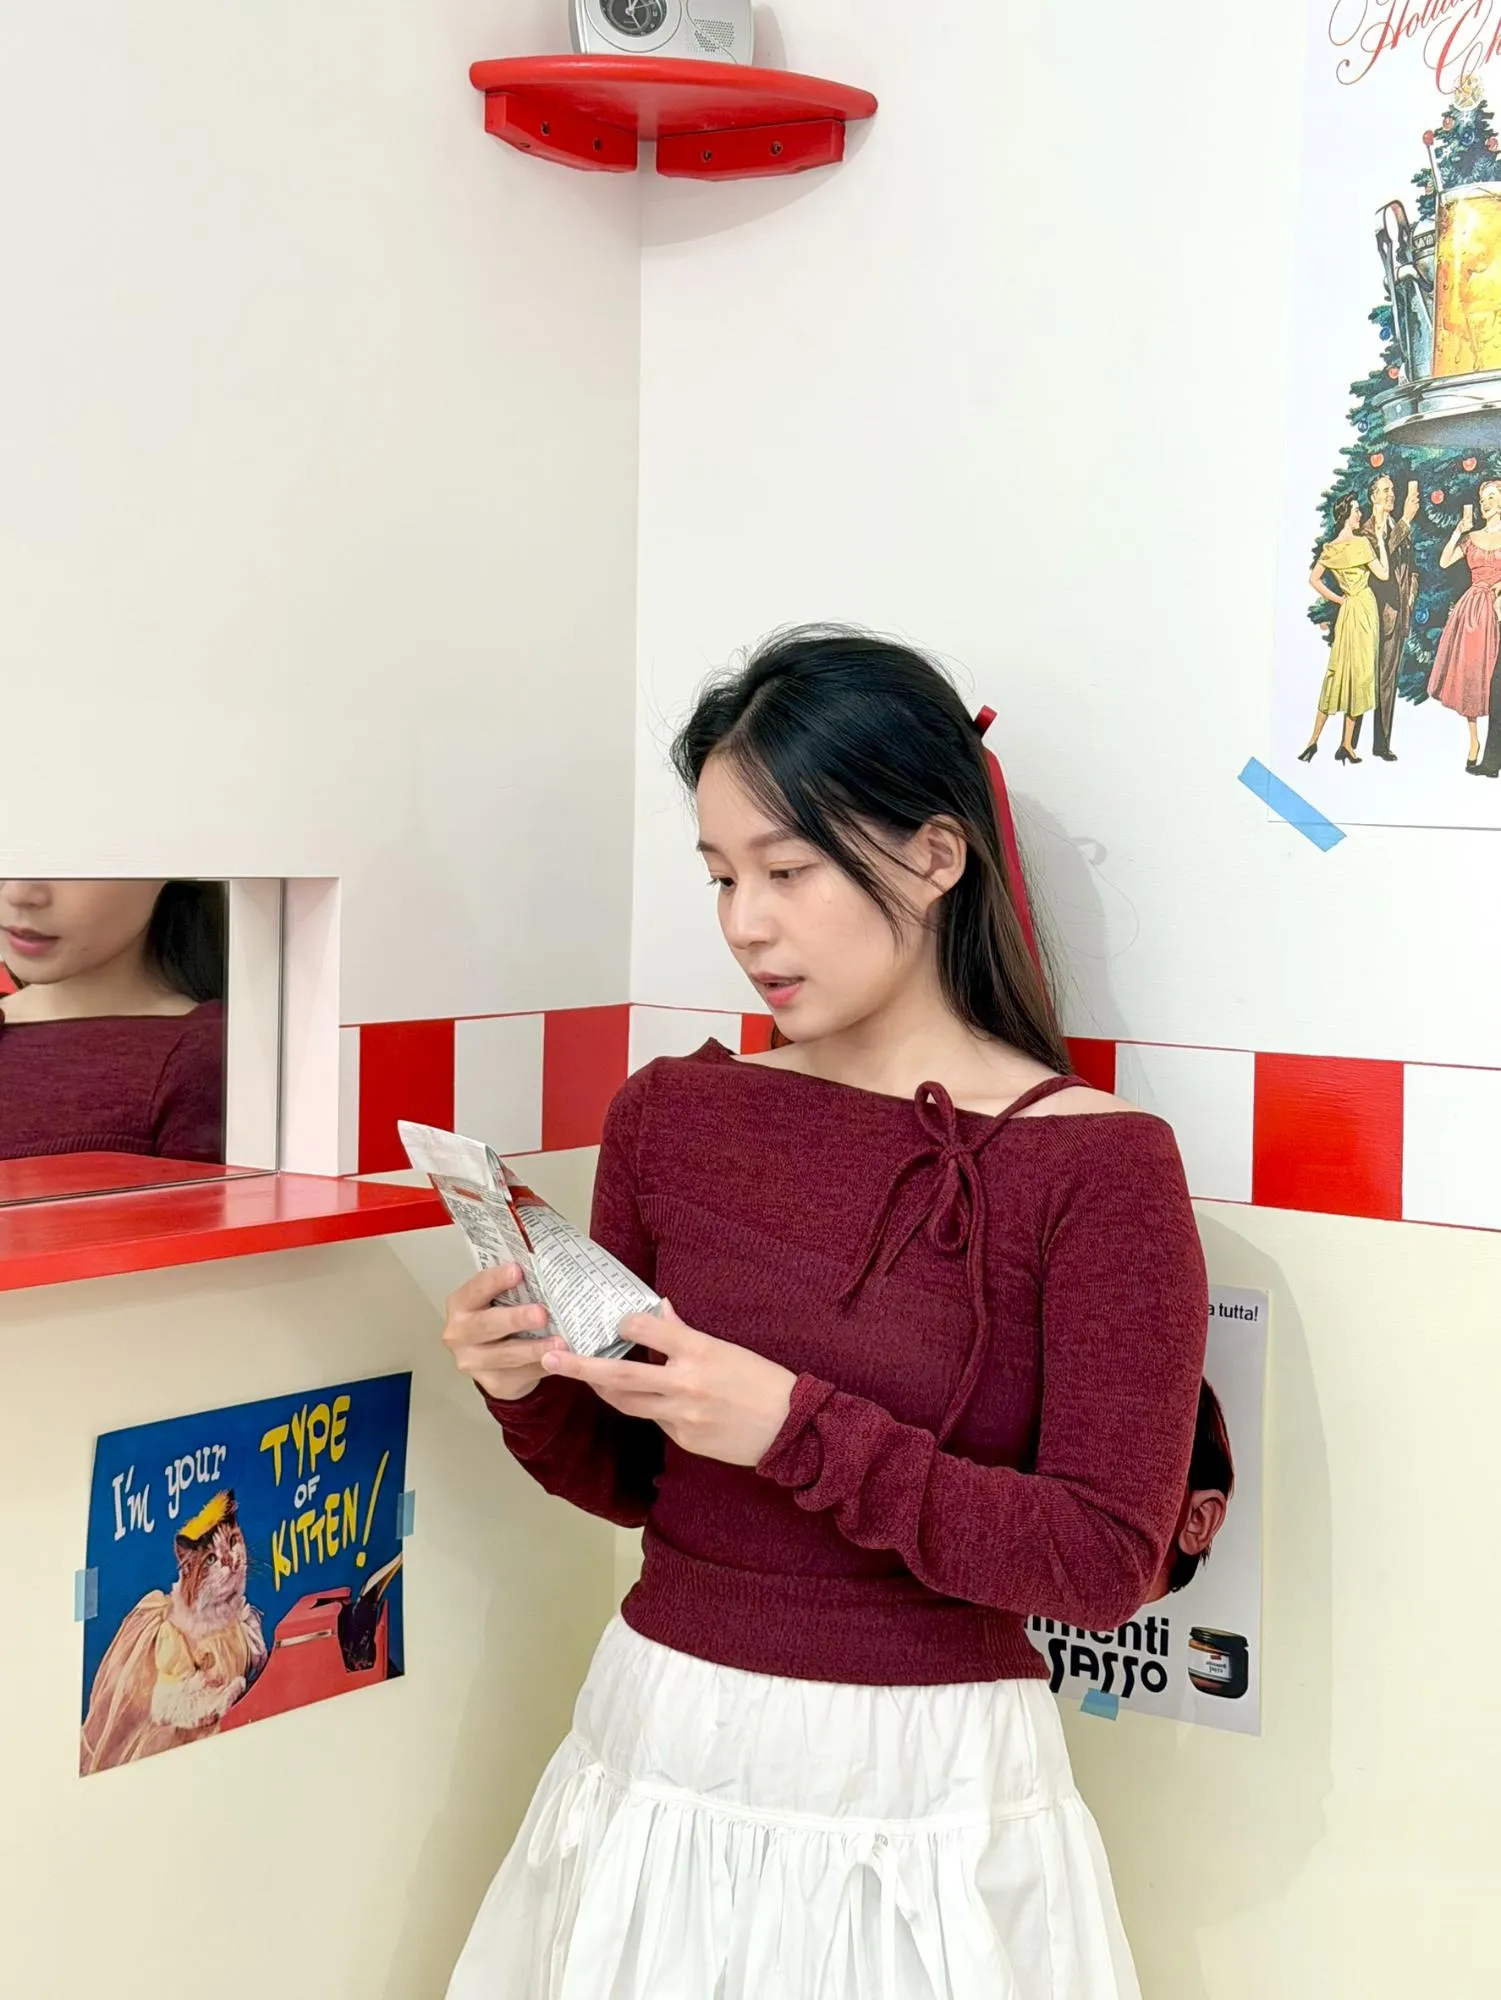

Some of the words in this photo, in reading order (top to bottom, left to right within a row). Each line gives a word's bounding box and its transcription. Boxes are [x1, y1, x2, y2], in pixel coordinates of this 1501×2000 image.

[1219, 1303, 1259, 1322] tutta!
[259, 1394, 351, 1487] TYPE
[112, 1464, 155, 1541] I'm
[165, 1444, 227, 1519] your
[272, 1450, 390, 1592] KITTEN!
[294, 1475, 321, 1509] OF
[1048, 1638, 1168, 1699] SASSO
